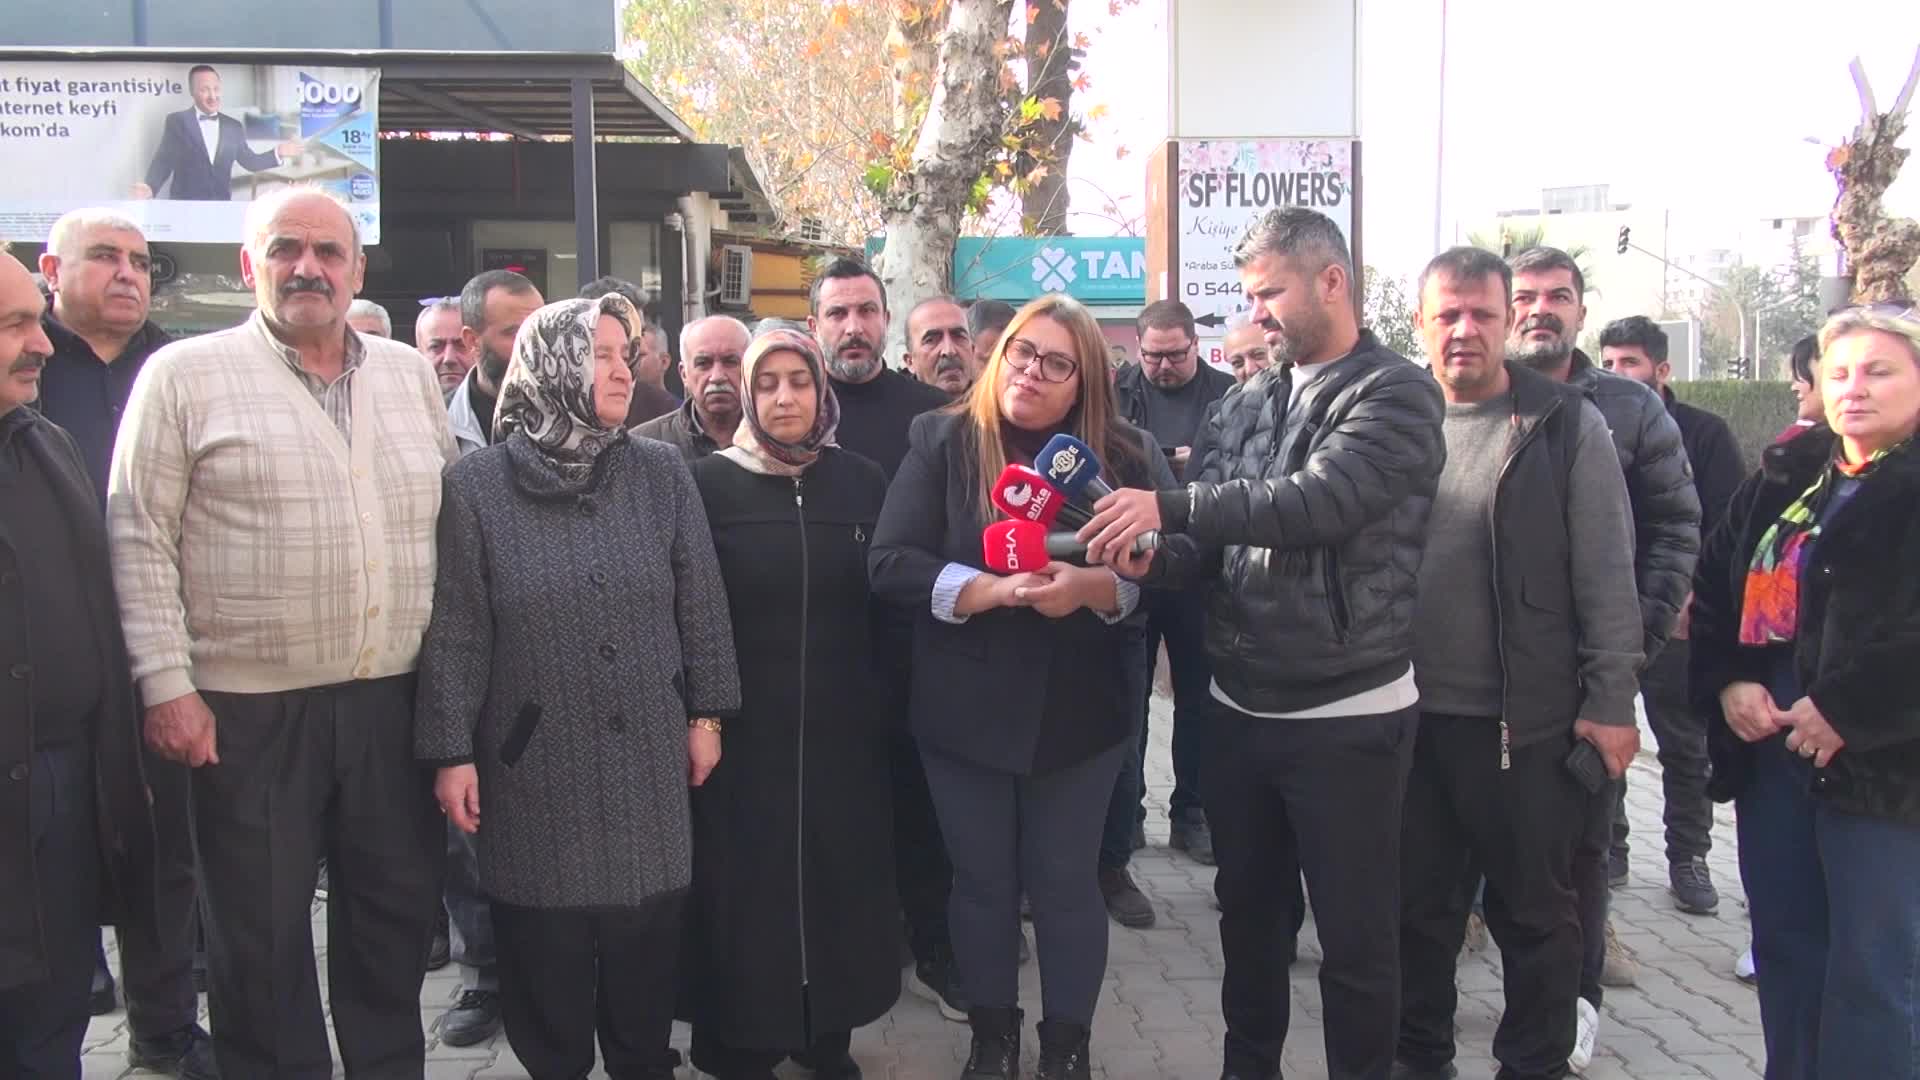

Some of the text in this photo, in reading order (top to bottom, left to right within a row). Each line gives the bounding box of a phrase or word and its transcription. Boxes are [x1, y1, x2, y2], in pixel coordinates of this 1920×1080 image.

[0, 77, 183, 96] t fiyat garantisiyle
[296, 81, 361, 104] 1000
[69, 100, 117, 117] keyfi
[1, 122, 70, 137] kom'da
[342, 130, 361, 144] 18
[1188, 171, 1342, 208] SF FLOWERS
[1204, 282, 1242, 296] 544
[1026, 488, 1049, 519] anka
[1006, 527, 1019, 570] DHA
